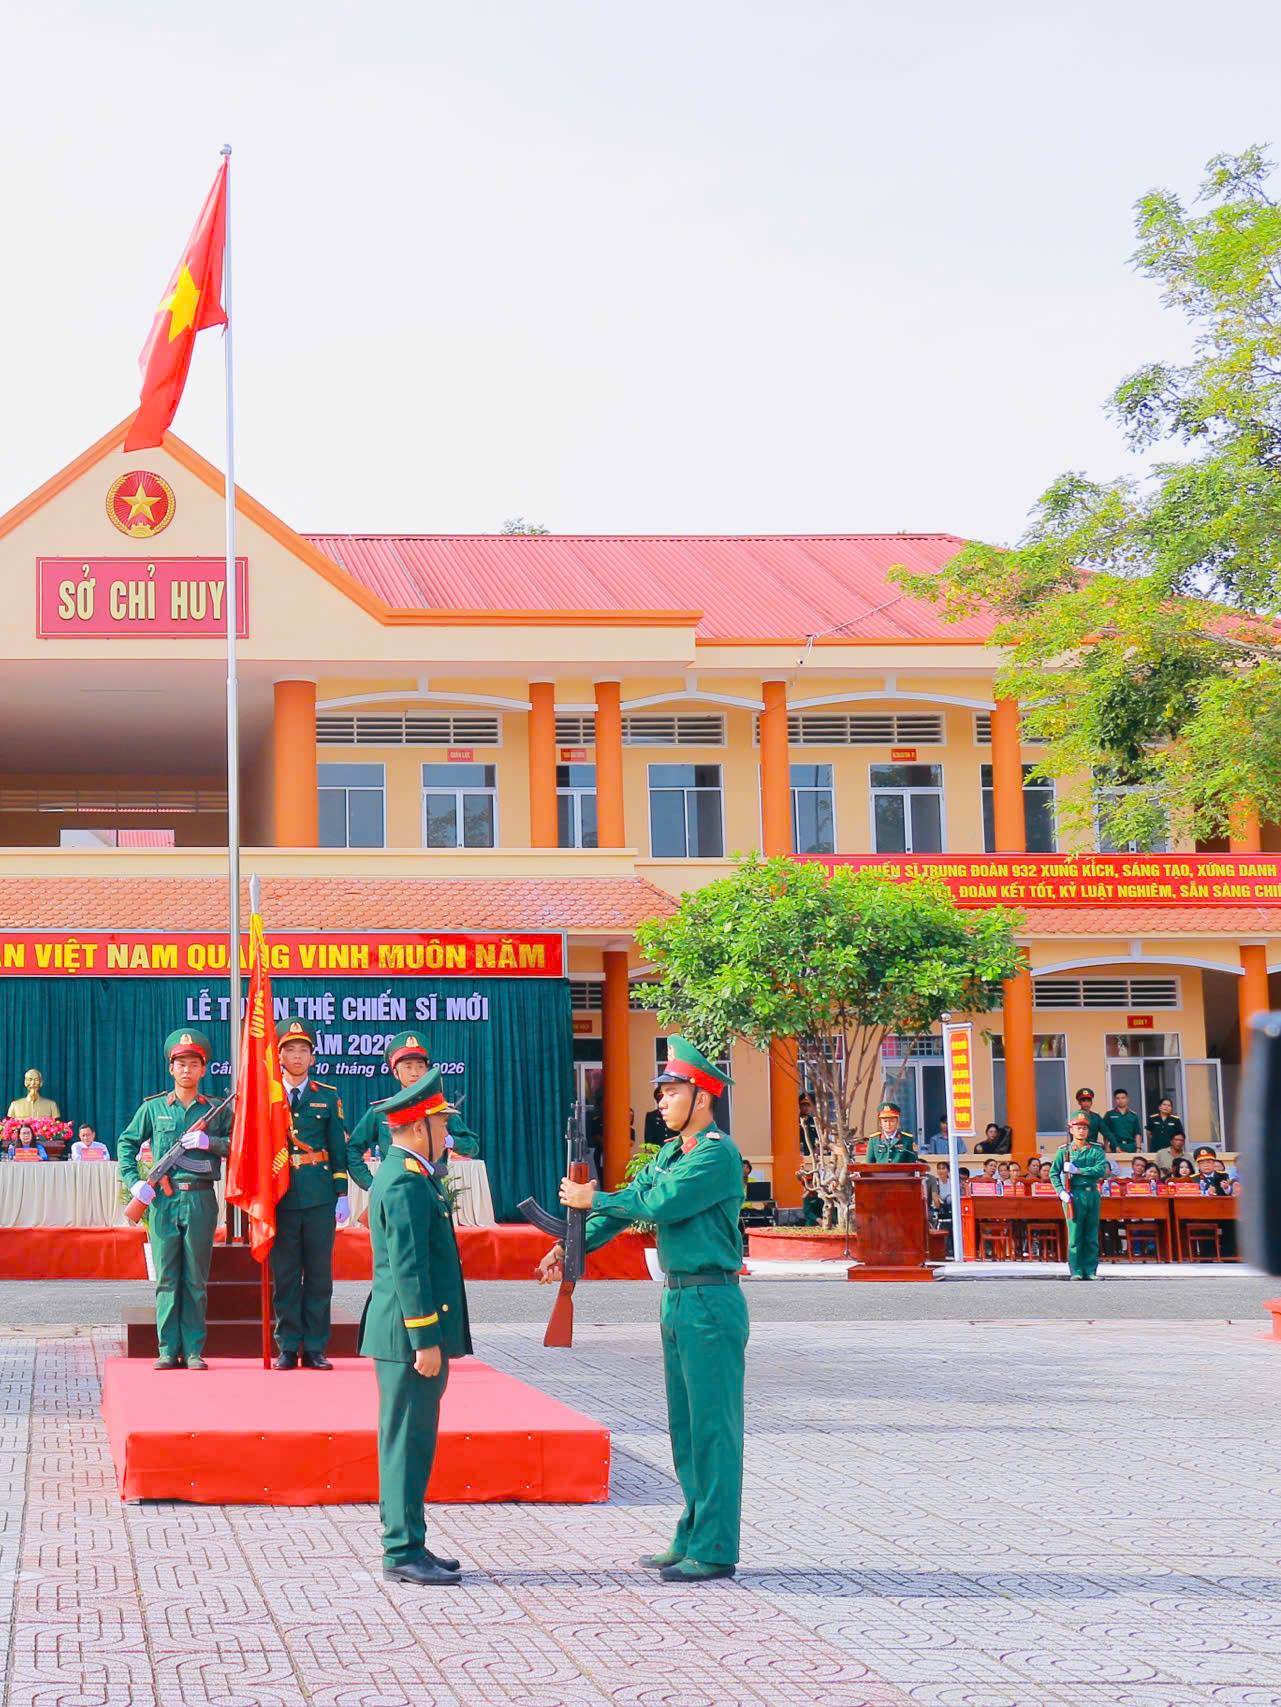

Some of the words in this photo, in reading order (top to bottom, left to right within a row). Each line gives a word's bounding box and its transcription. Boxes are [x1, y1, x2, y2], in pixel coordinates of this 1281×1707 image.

[58, 563, 96, 621] SỞ
[109, 563, 156, 621] CHỈ
[171, 580, 225, 621] HUY
[921, 864, 967, 877] TRUNG
[970, 862, 1008, 877] ĐOÀN
[1012, 864, 1037, 877] 932
[1041, 864, 1078, 877] XUNG
[1123, 861, 1160, 877] SÁNG
[1163, 864, 1193, 879] TẠO,
[1197, 861, 1235, 877] XỨNG
[1239, 864, 1277, 877] DANH
[959, 883, 997, 898] ĐOÀN
[1001, 881, 1025, 898] KẾT
[1029, 881, 1056, 899] TỐT,
[1081, 883, 1113, 900] LUẬT
[1117, 883, 1176, 899] NGHIÊM,
[1213, 882, 1251, 898] SÀNG
[34, 938, 98, 972] VIỆT
[107, 943, 178, 969] NAM
[299, 944, 369, 969] VINH
[378, 939, 466, 969] MUÔN
[475, 939, 545, 969] NĂM
[187, 988, 212, 1021] LỄ
[295, 992, 335, 1025] THỆ
[342, 989, 406, 1021] CHIẾN
[415, 993, 438, 1021] SĨ
[446, 992, 489, 1021] MỚI
[315, 1062, 329, 1074] 10
[335, 1062, 375, 1078] tháng
[380, 1062, 389, 1074] 6
